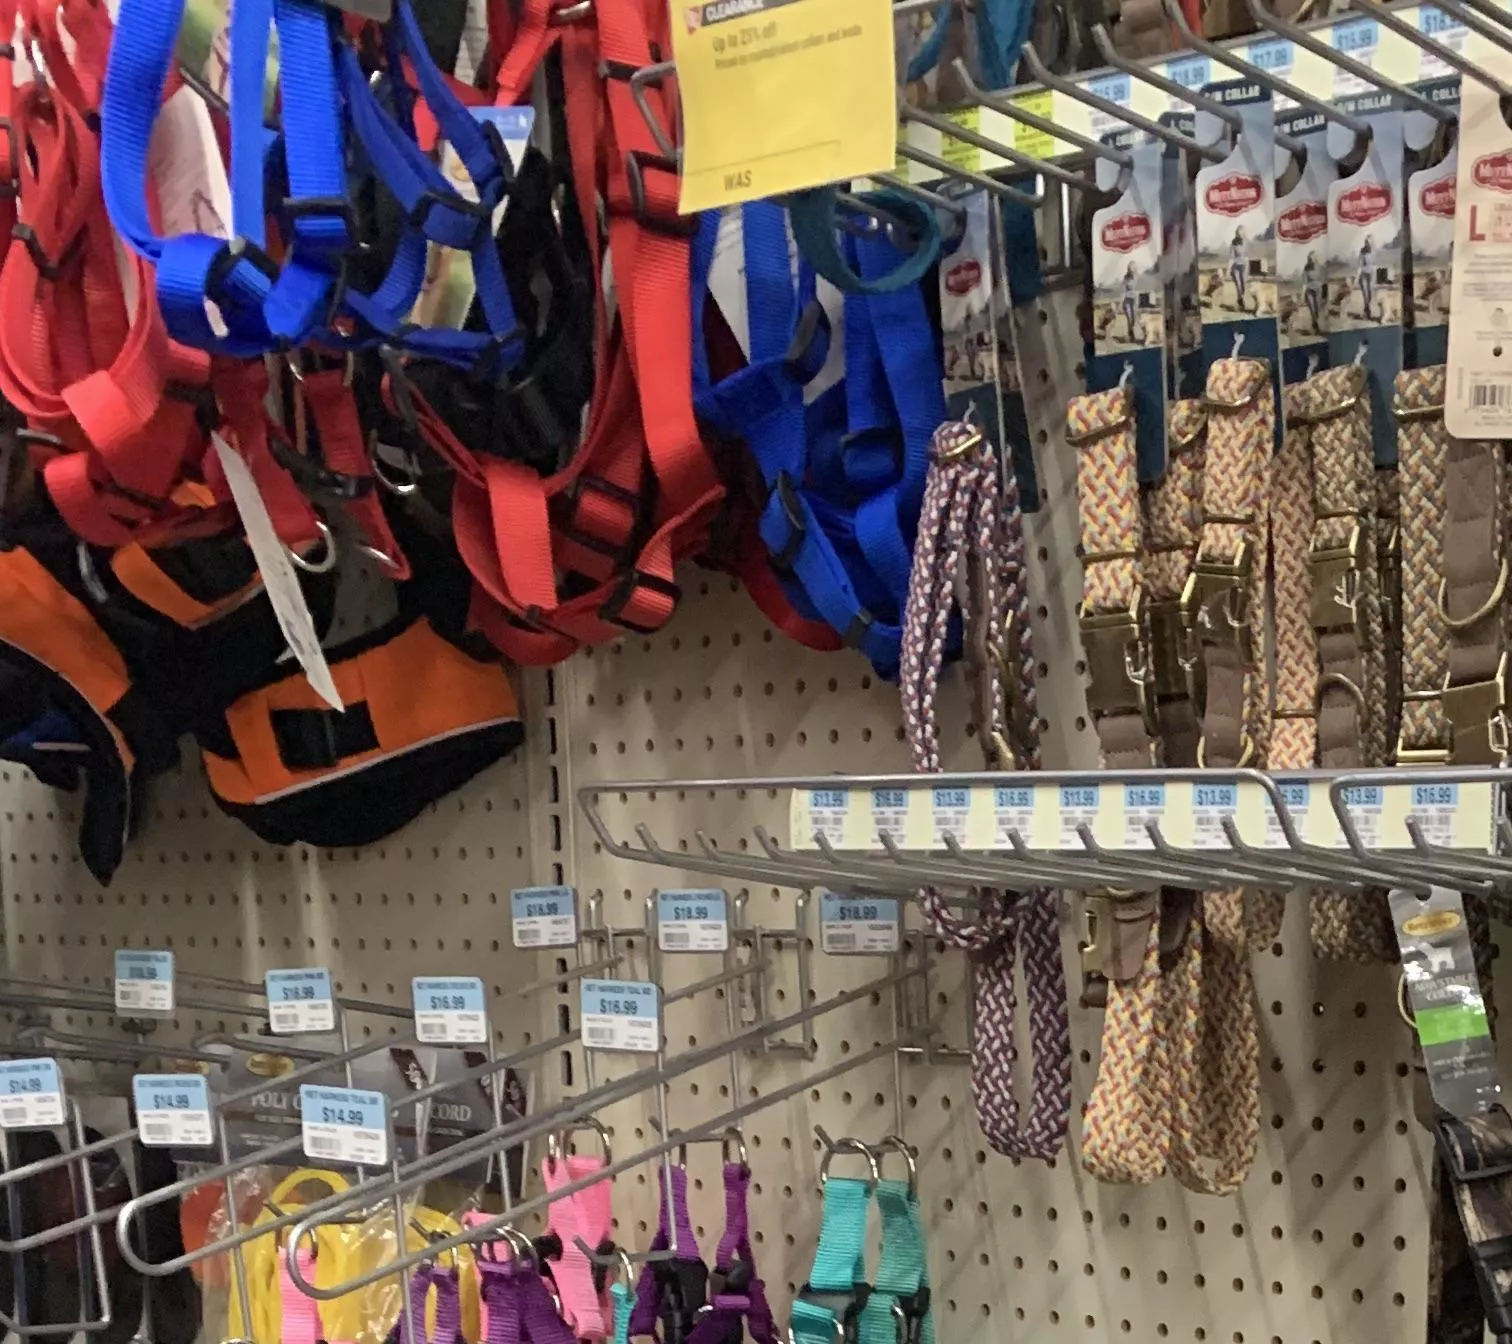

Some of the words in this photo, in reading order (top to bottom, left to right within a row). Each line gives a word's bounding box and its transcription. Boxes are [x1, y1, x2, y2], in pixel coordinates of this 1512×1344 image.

[1225, 84, 1261, 100] COLLAR
[1357, 95, 1392, 110] COLLAR
[1292, 114, 1326, 131] COLLAR
[723, 169, 752, 192] WAS
[1469, 205, 1487, 242] L
[1415, 785, 1452, 805] $16.99
[673, 906, 709, 920] $18.99
[838, 904, 878, 921] $18.99
[599, 998, 638, 1015] $16.99
[153, 1094, 190, 1109] $14.99
[322, 1107, 364, 1126] $14.99
